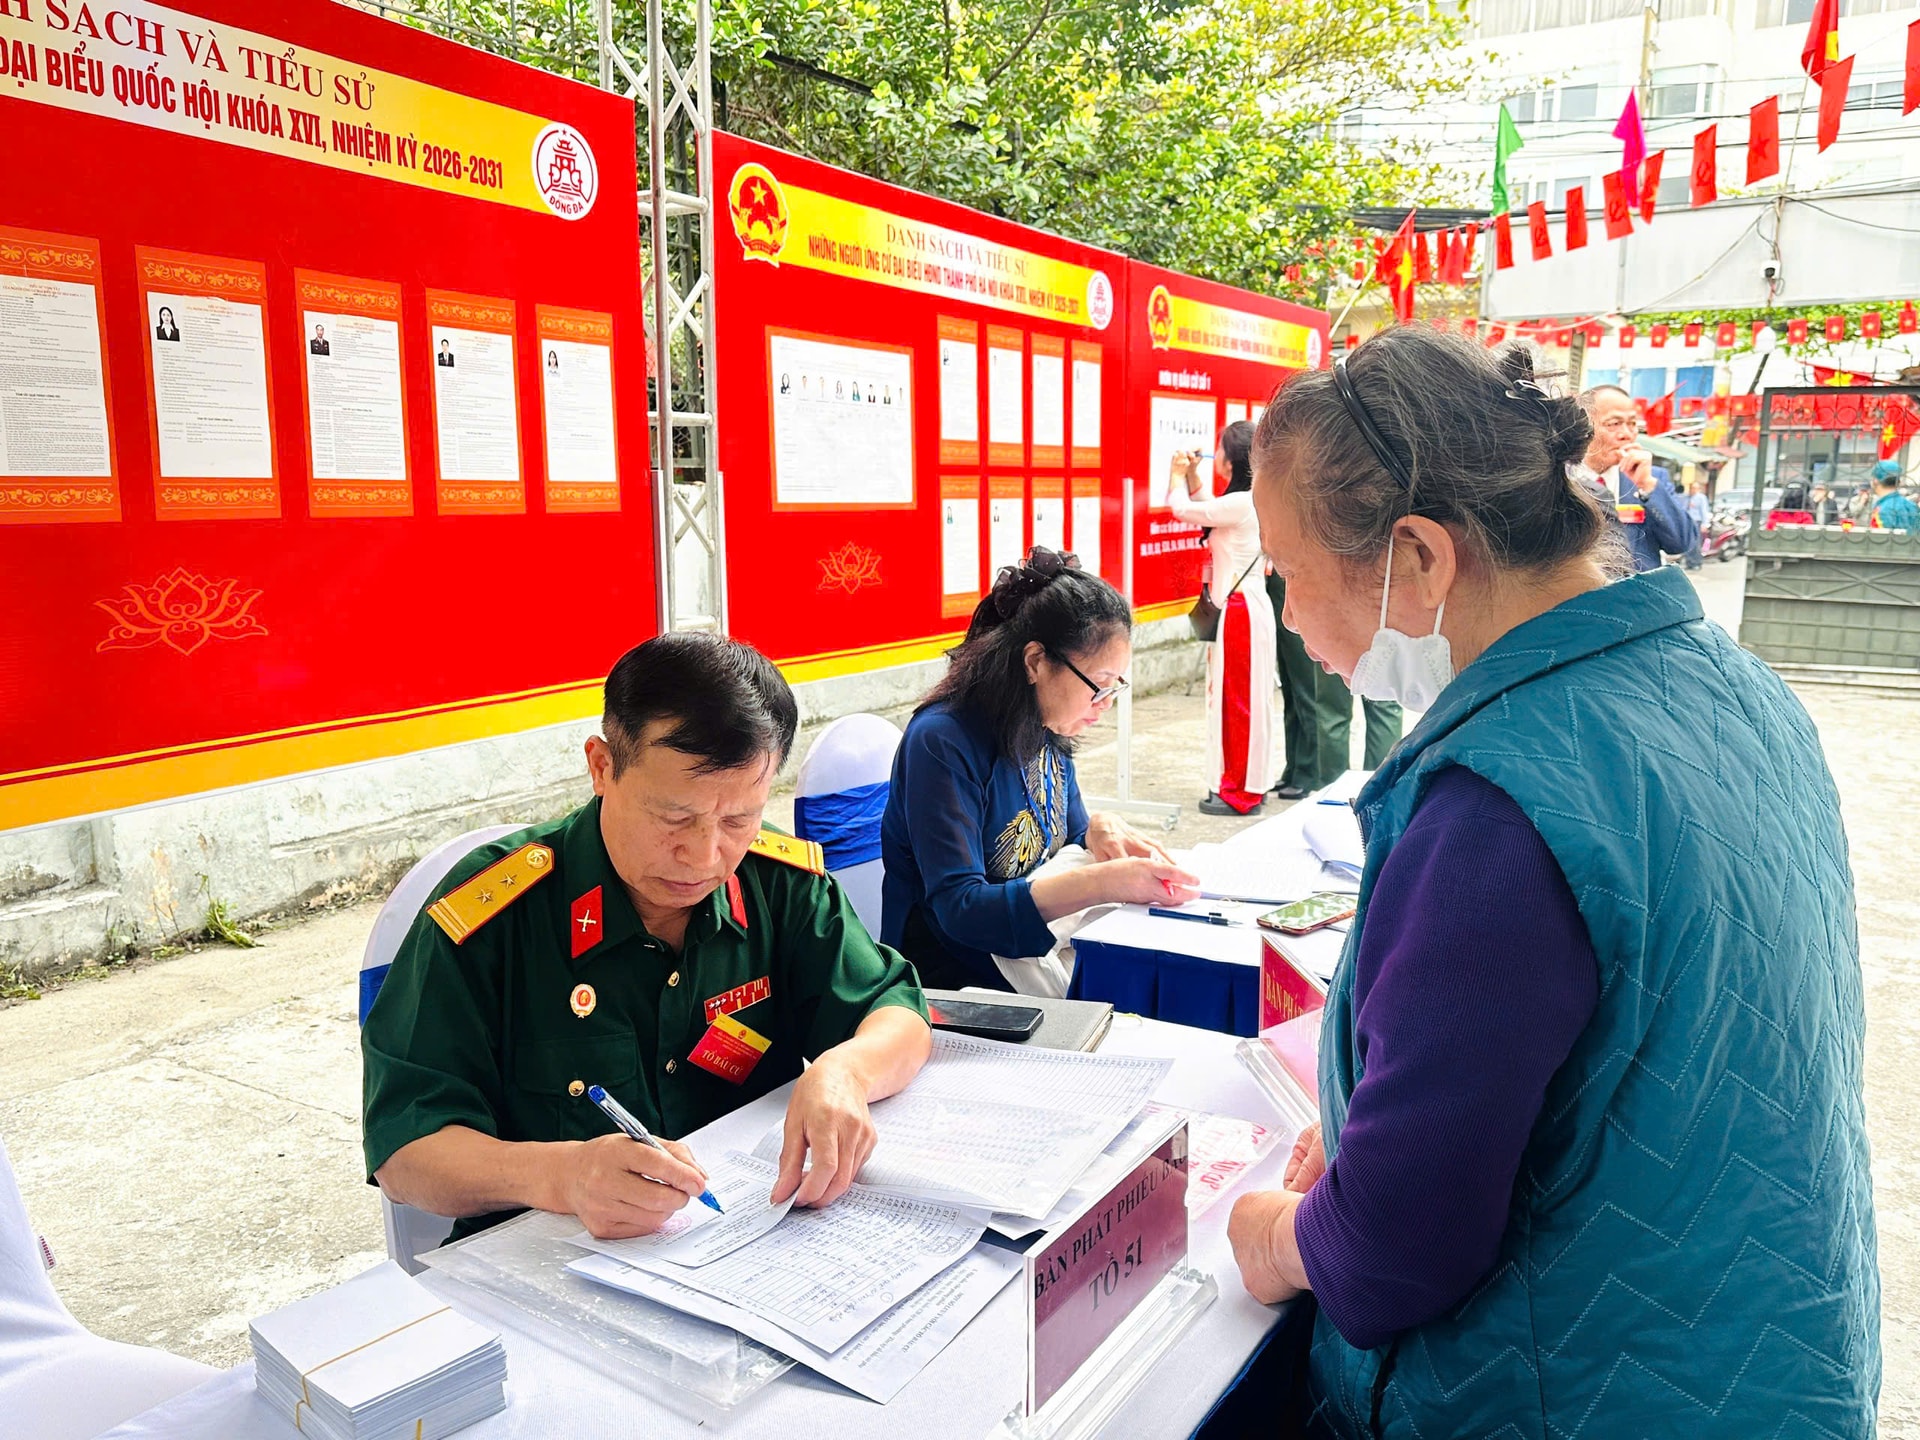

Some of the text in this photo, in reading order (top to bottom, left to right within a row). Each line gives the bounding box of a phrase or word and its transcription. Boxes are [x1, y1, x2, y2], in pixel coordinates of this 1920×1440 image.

[176, 29, 229, 73] VÀ
[238, 47, 324, 98] TIỂU
[334, 72, 375, 111] SỬ
[45, 41, 105, 97] BIỂU
[112, 62, 176, 114] QUỐC
[182, 79, 221, 130] HỘI
[226, 94, 284, 139] KHÓA
[288, 108, 326, 153] XVI,
[332, 120, 392, 166] NHIỆM
[396, 133, 418, 170] KỲ
[422, 144, 503, 189] 2026-2031
[808, 232, 836, 262] NHỮNG
[839, 241, 862, 268] NGƯỜI
[864, 243, 880, 271] ỨNG
[886, 223, 925, 252] DANH
[929, 232, 963, 261] SÁCH
[1266, 970, 1282, 1014] BÀN
[702, 1050, 718, 1062] TỔ
[713, 1056, 731, 1070] BẦU
[1034, 1250, 1068, 1300] BÀN
[1072, 1208, 1114, 1264] PHÁT
[1117, 1168, 1158, 1224] PHIẾU
[1089, 1234, 1142, 1312] TỔ 51
